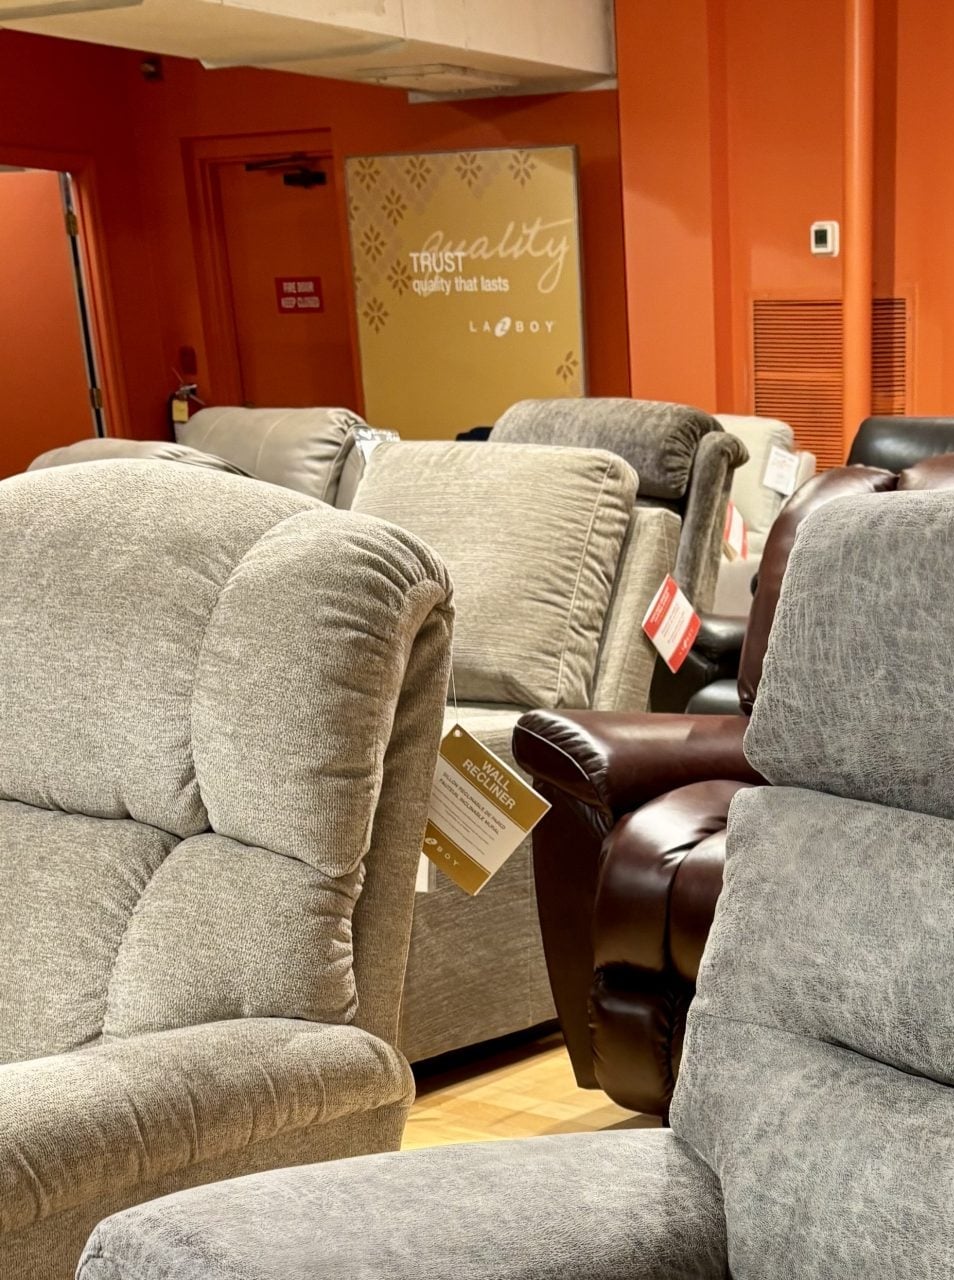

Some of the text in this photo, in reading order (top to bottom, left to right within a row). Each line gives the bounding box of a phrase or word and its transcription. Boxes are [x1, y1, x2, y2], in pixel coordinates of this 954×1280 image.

[409, 250, 465, 273] TRUST
[412, 275, 509, 296] quality that lasts
[462, 759, 517, 809] RECLINER
[482, 761, 511, 791] WALL
